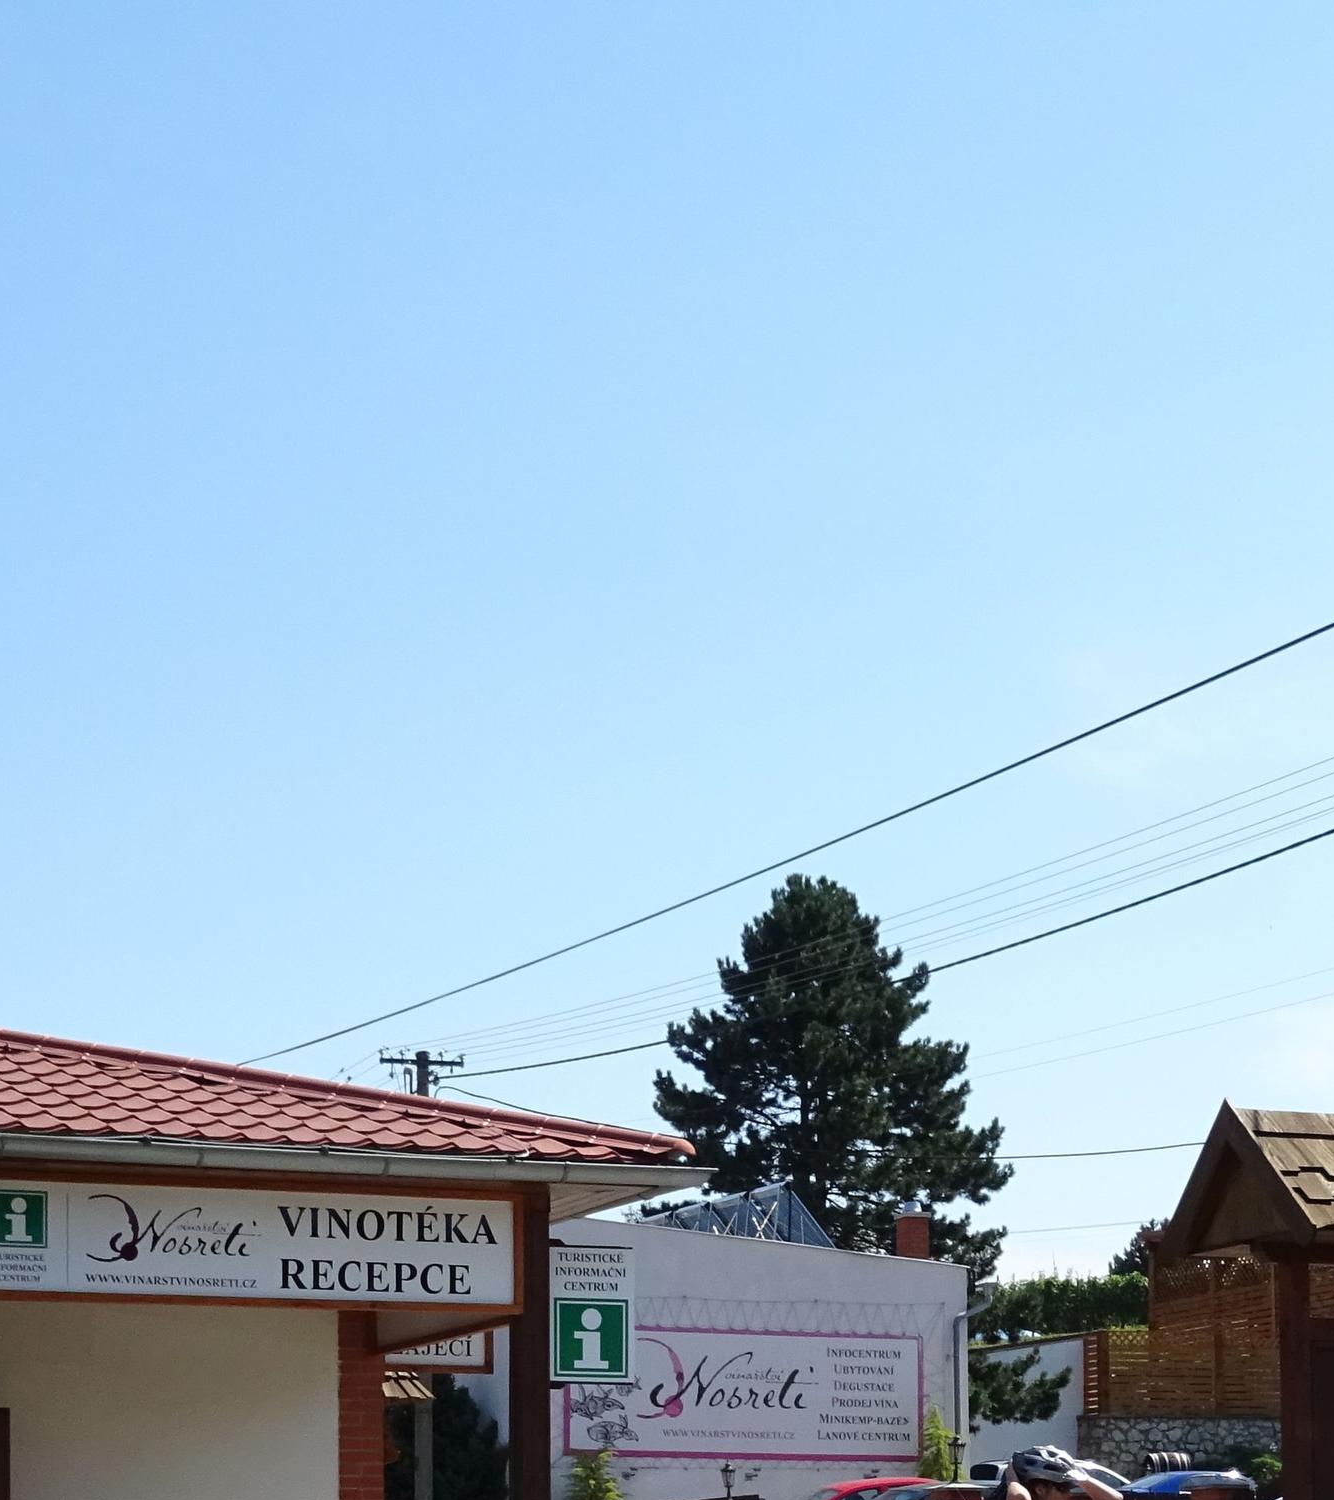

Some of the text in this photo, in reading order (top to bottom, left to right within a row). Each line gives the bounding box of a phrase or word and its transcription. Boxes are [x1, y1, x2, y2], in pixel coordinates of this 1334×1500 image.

[277, 1205, 499, 1245] VINOTÉKA
[557, 1251, 624, 1263] TURISTICKÉ
[279, 1258, 472, 1296] RECEPCE
[555, 1265, 627, 1278] INFORMAČNÍ
[85, 1273, 258, 1289] WWW.VINARSTVINOSRETI.CZ
[563, 1281, 619, 1292] CENTRUM
[827, 1347, 902, 1359] INFOCENTRUM
[834, 1364, 895, 1375] UBYTOVÁNÍ
[833, 1380, 896, 1392] DEGUSTACE
[831, 1396, 899, 1409] PRODEJ VÍNA
[861, 1432, 912, 1442] CENTRUM
